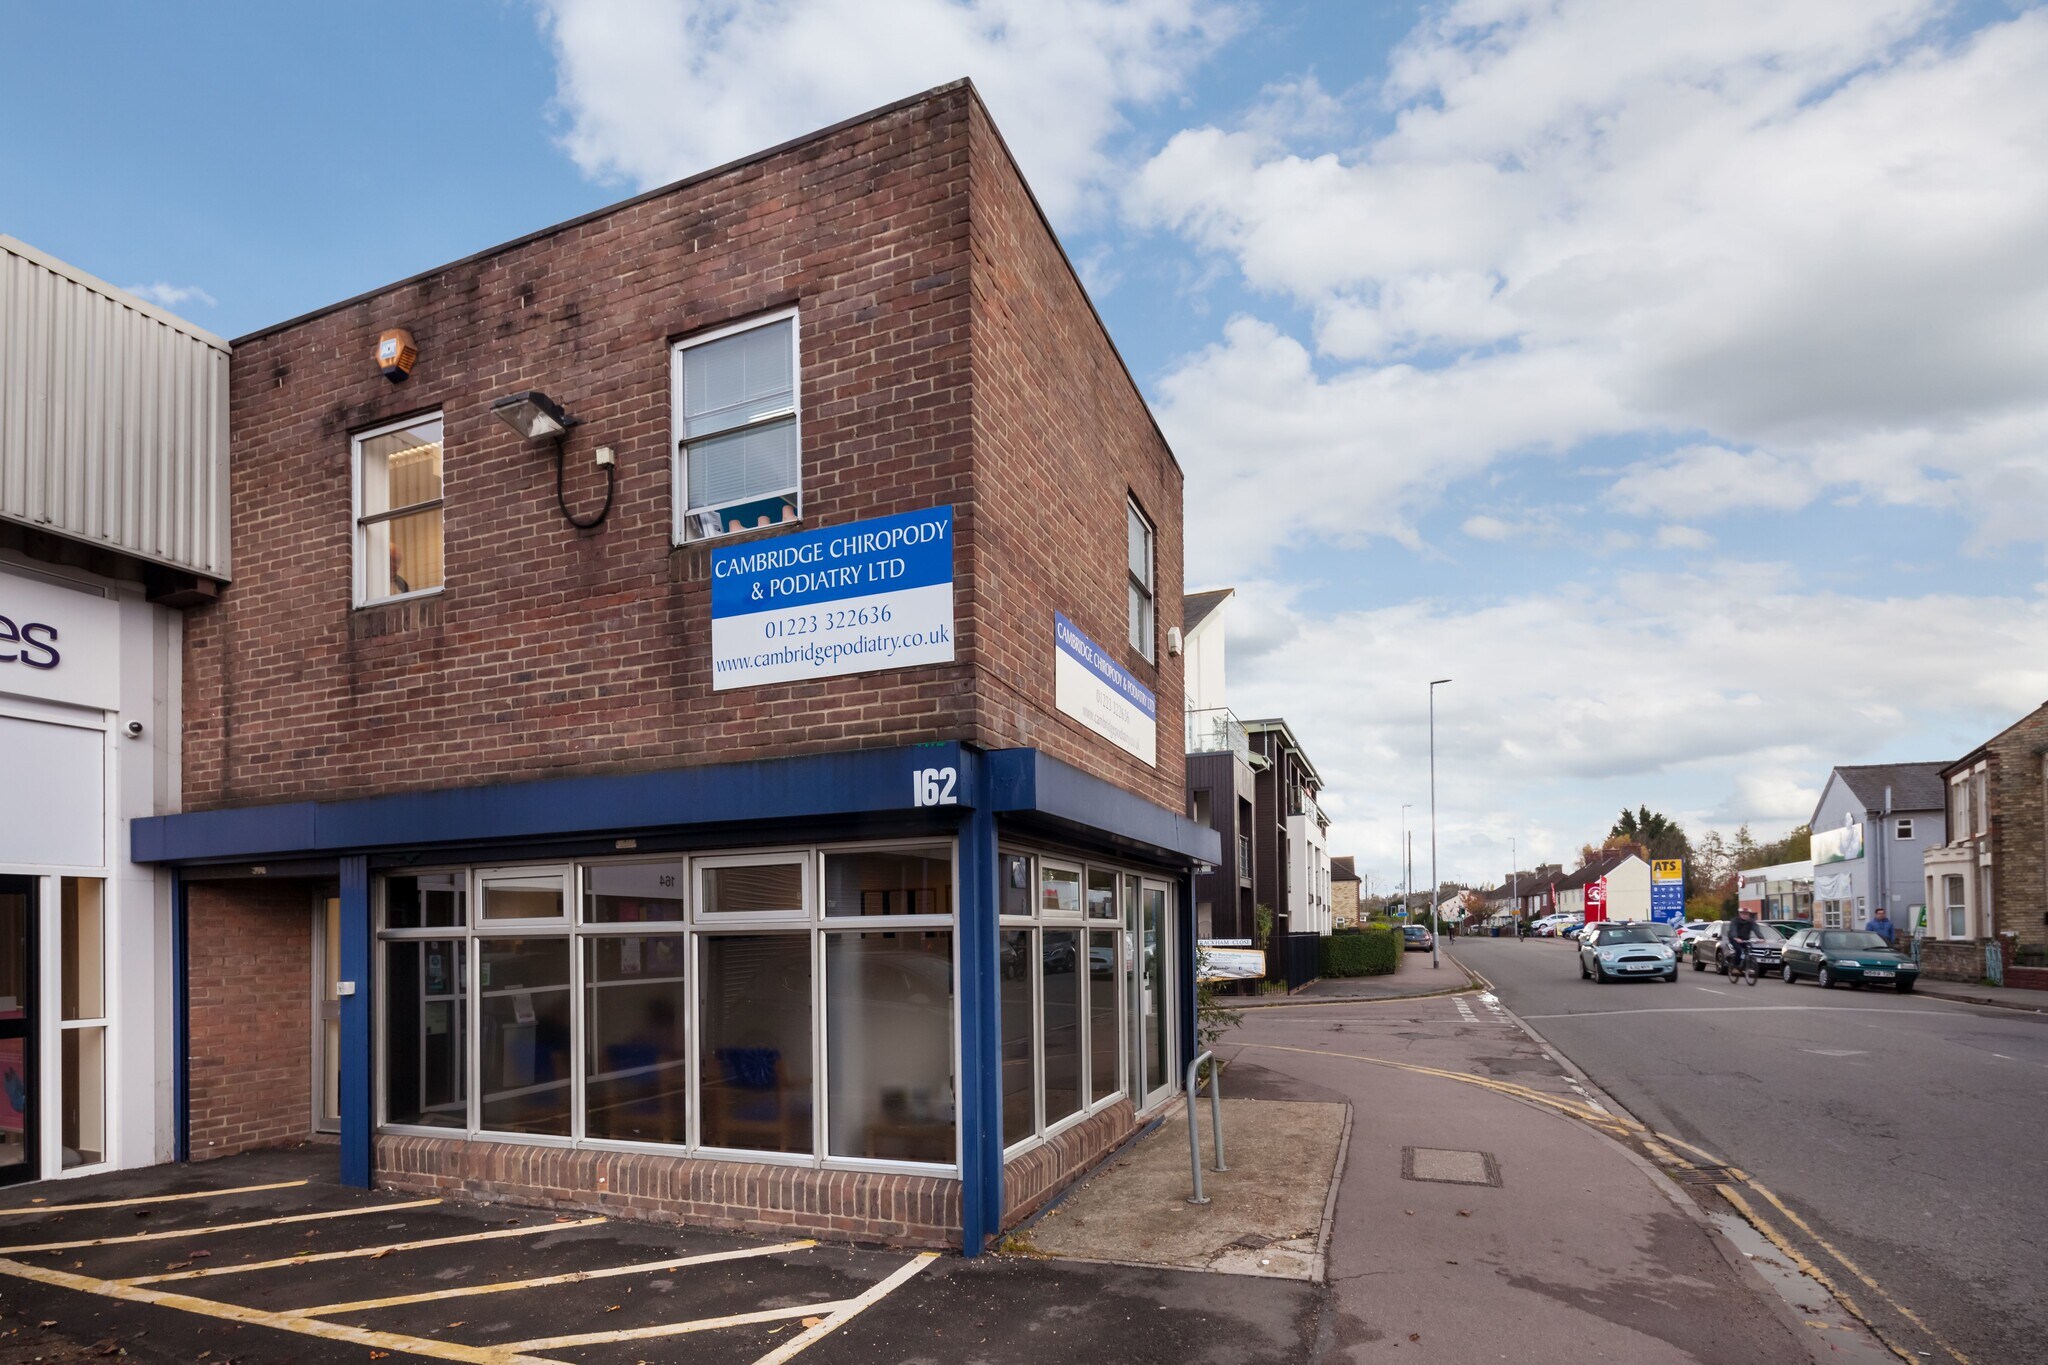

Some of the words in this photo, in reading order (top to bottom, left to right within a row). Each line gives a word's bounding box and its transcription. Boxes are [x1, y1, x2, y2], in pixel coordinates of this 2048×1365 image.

[715, 543, 823, 578] CAMBRIDGE
[829, 520, 948, 559] CHIROPODY
[751, 581, 764, 600] &
[770, 565, 862, 598] PODIATRY
[868, 558, 905, 582] LTD
[765, 615, 817, 638] 01223
[825, 603, 891, 631] 322636
[716, 624, 949, 672] www.cambridgepodiatry.co.uk
[1057, 622, 1093, 663] CAMBRIDGE
[913, 767, 957, 807] 162
[1653, 861, 1676, 871] ATS
